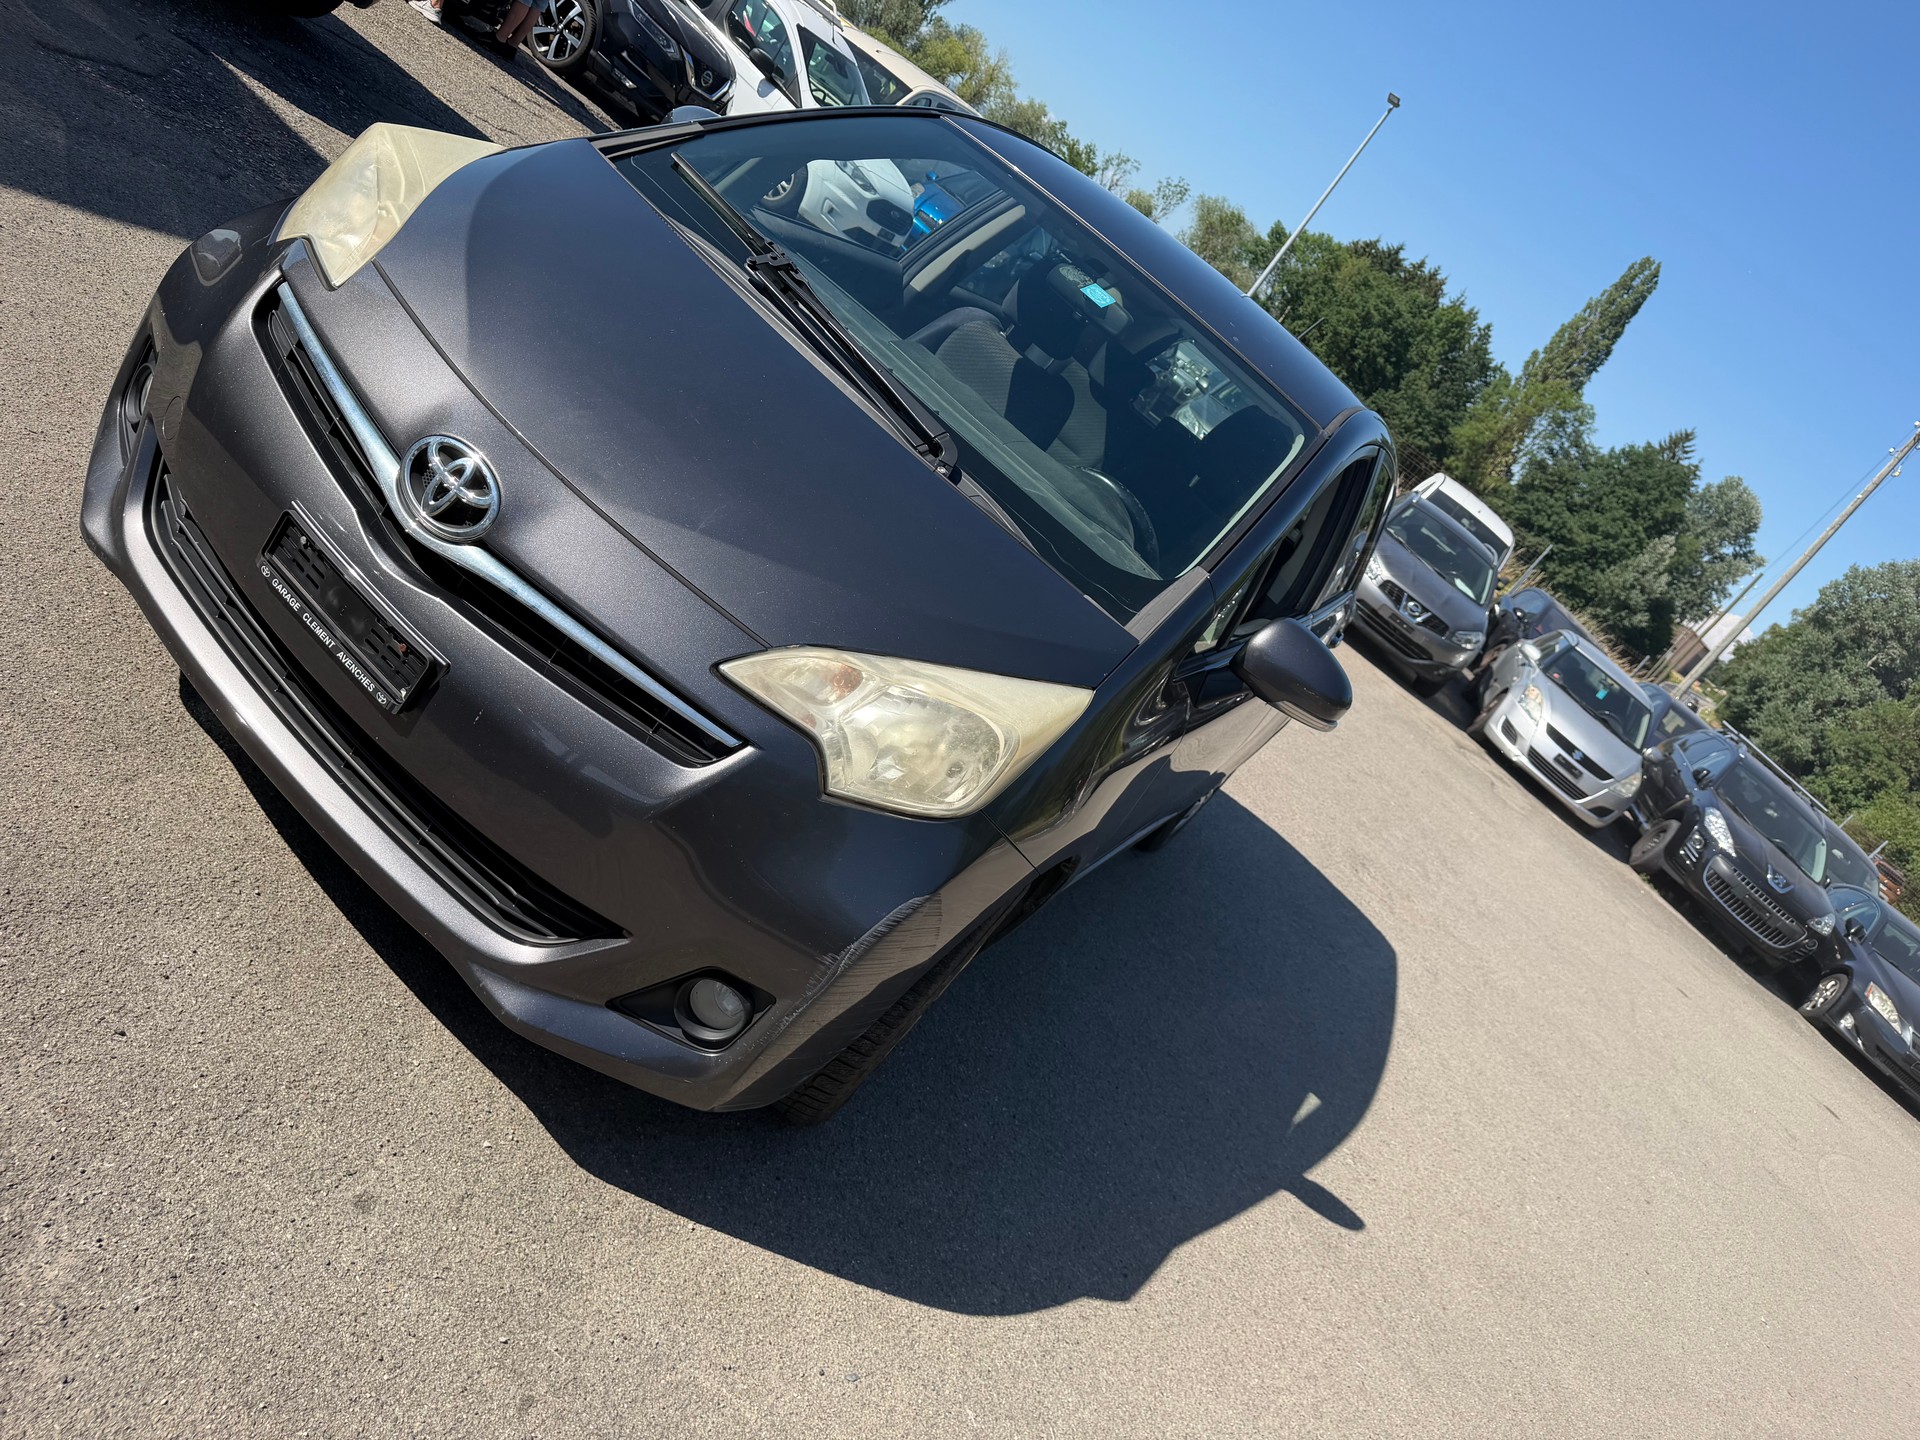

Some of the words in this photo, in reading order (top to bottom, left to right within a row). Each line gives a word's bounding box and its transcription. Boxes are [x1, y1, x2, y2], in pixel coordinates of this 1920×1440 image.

[272, 578, 301, 612] GARAGE
[302, 613, 336, 649] CLEMENT
[336, 651, 376, 692] AVENCHES
